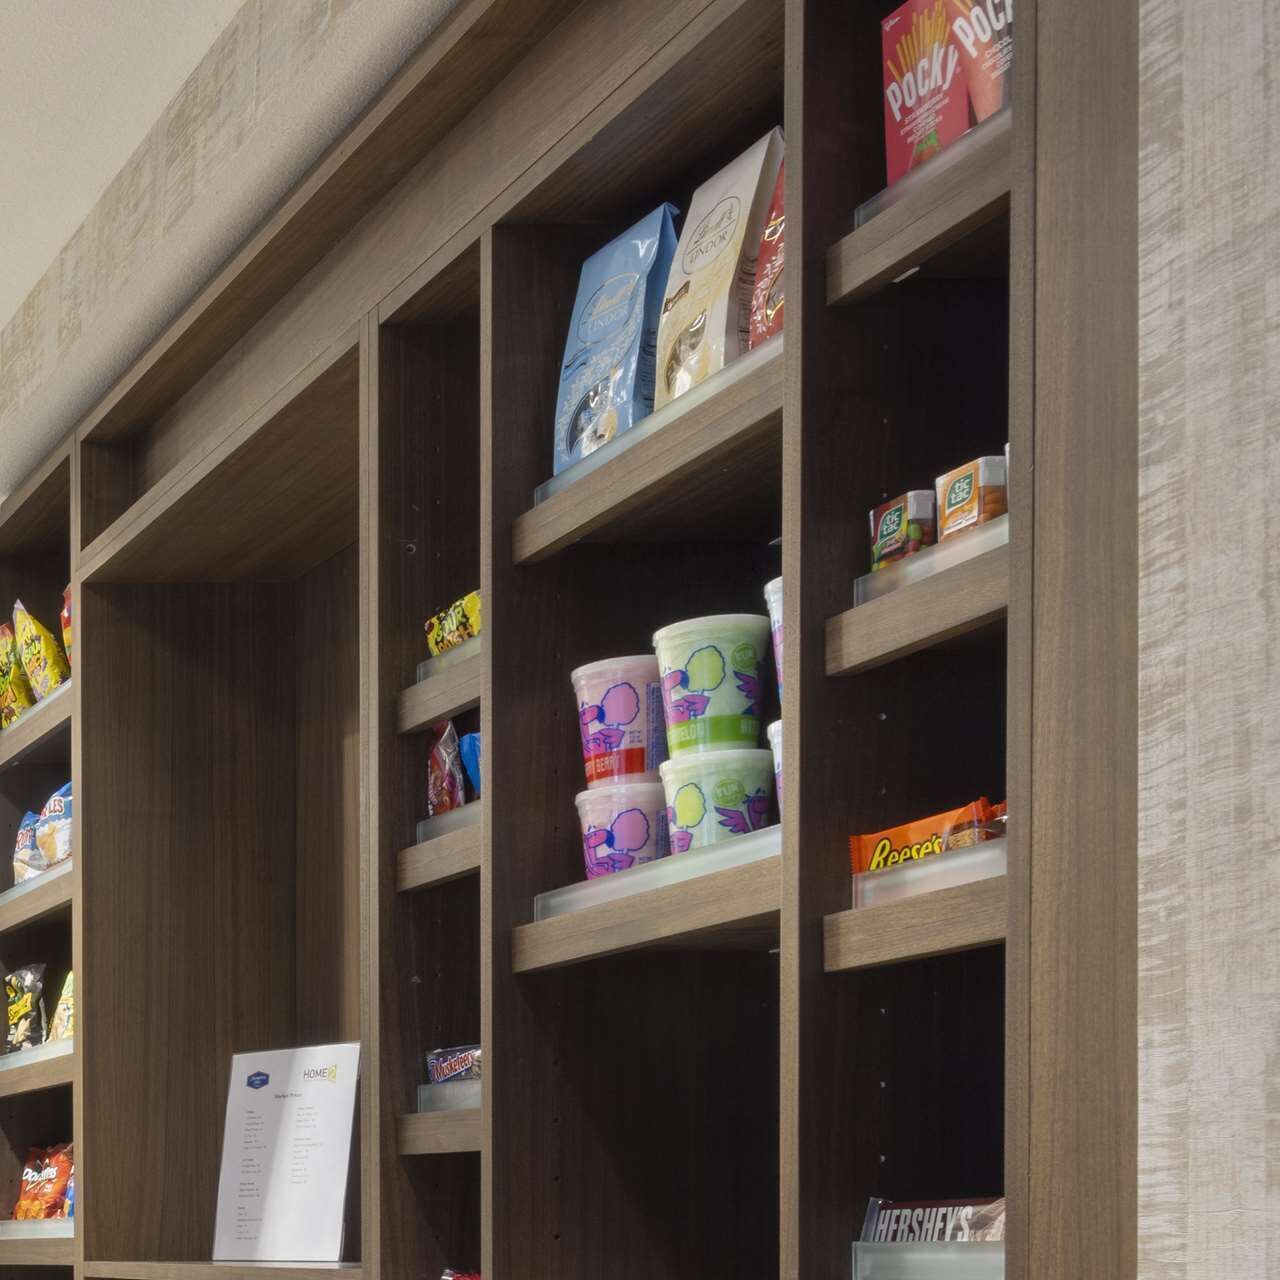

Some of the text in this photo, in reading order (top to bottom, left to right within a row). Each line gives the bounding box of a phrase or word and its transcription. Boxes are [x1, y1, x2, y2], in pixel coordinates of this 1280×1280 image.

[954, 478, 970, 493] tic
[951, 489, 970, 504] tac
[22, 1166, 58, 1182] Doritos
[875, 1205, 974, 1242] HERSHEY'S
